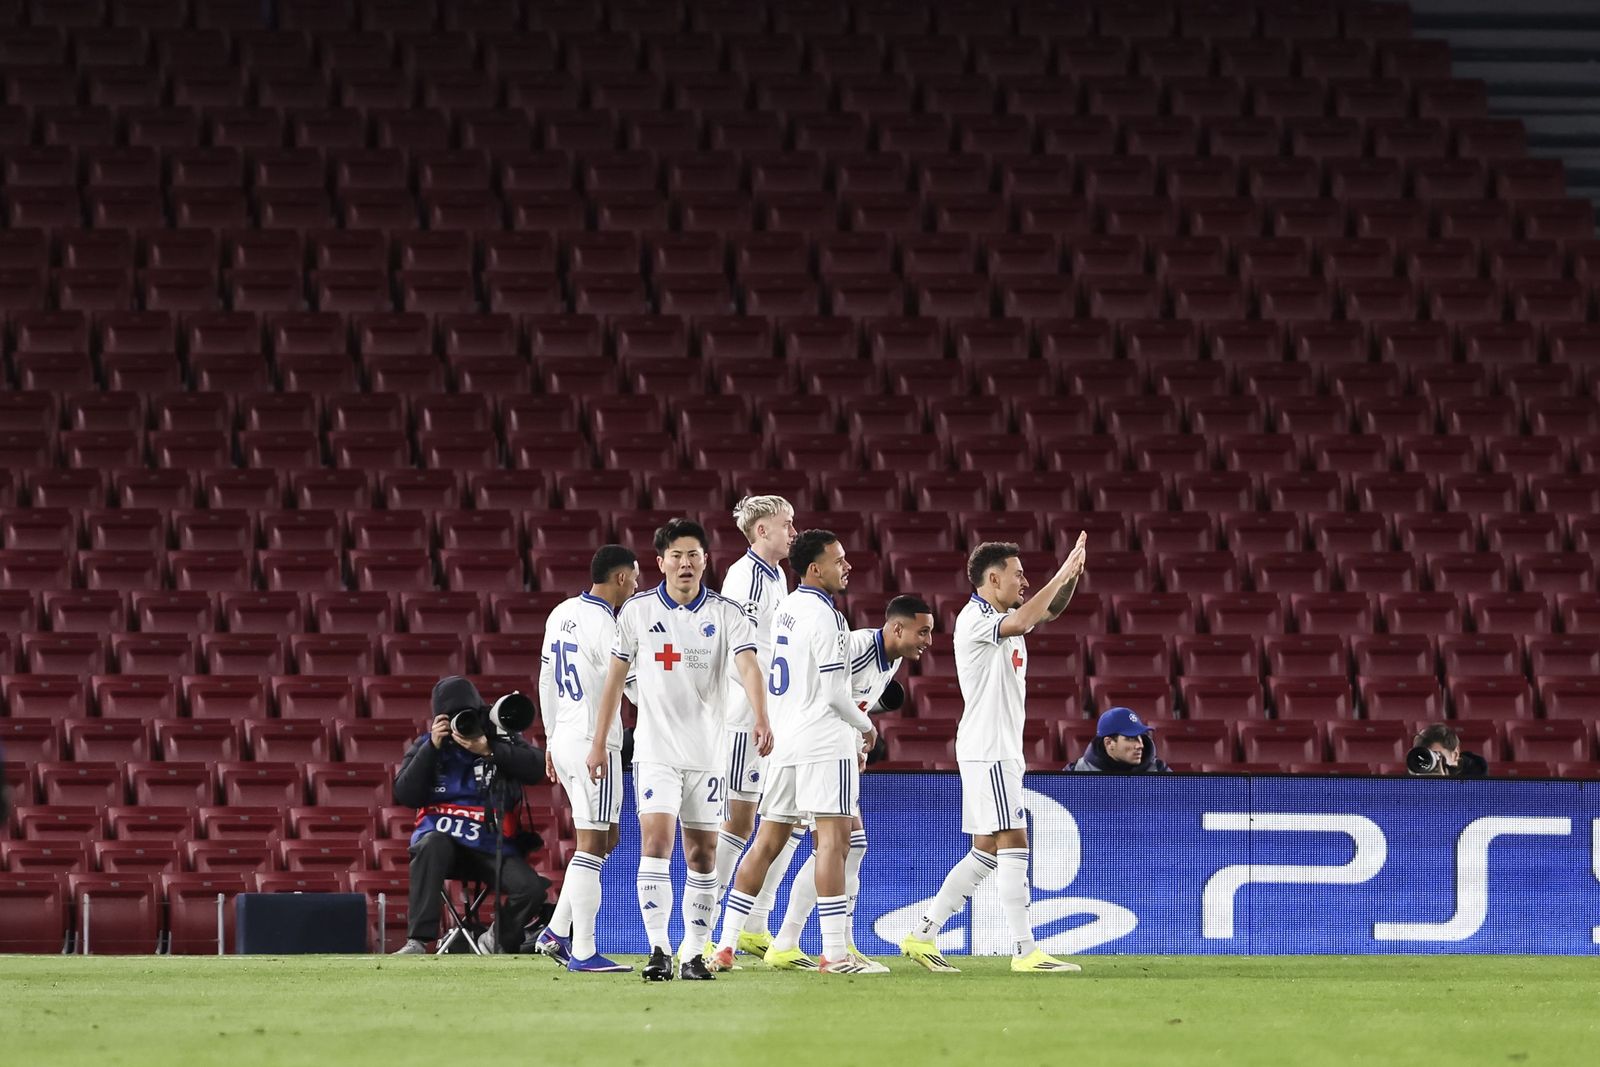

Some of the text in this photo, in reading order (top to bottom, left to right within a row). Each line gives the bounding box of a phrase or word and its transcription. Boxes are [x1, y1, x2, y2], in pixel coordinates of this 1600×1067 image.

[551, 640, 583, 702] 15
[769, 635, 790, 696] 5
[707, 776, 725, 802] 20
[436, 816, 482, 841] 013
[1202, 812, 1600, 942] PS
